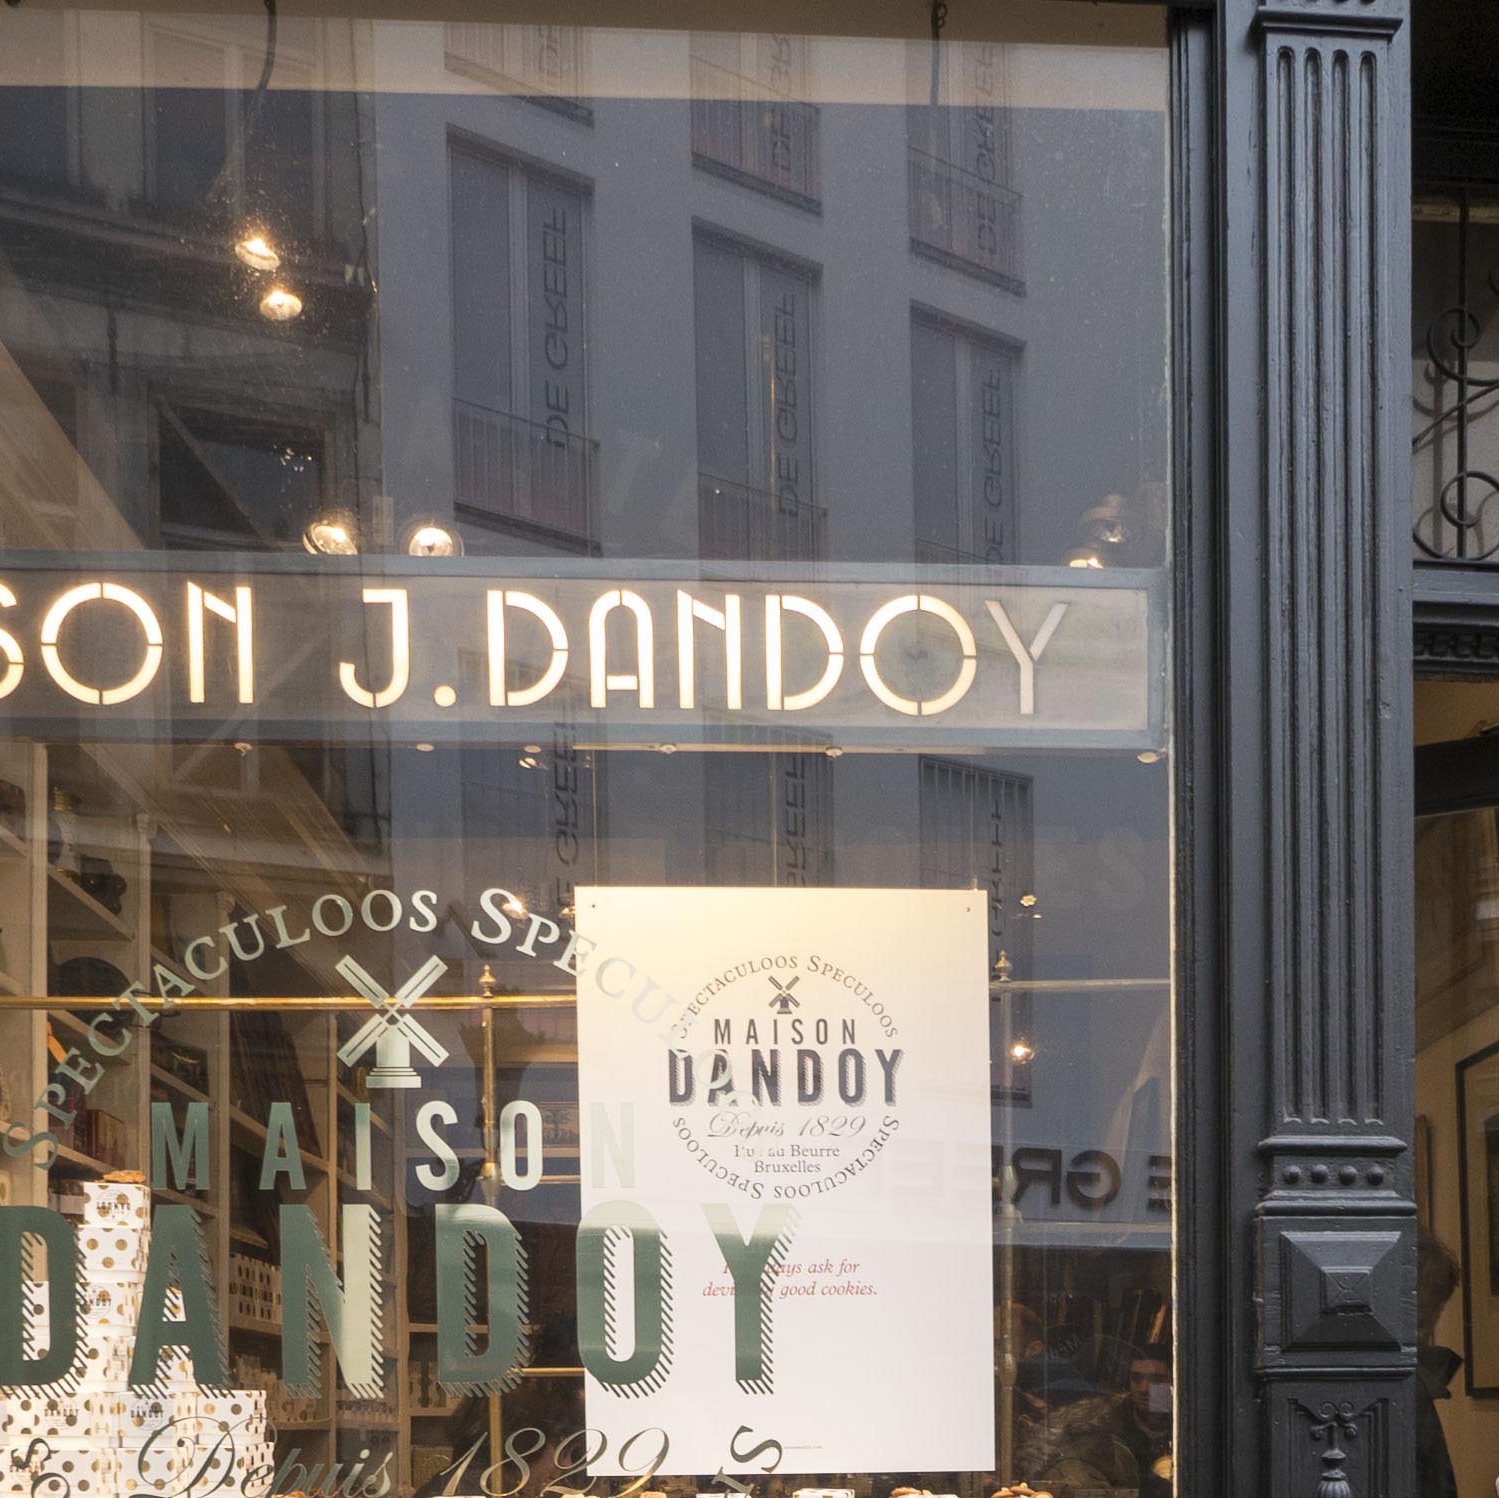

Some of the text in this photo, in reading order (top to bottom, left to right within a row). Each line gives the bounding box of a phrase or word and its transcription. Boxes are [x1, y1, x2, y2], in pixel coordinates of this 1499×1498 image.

[806, 954, 899, 1039] SPECULOOS
[714, 1018, 857, 1045] MAISON
[668, 1047, 905, 1108] DANDOY
[798, 1115, 867, 1138] 1829
[152, 1099, 637, 1191] MAISON
[790, 1143, 840, 1158] Beurre
[754, 1160, 822, 1174] Bruxelles
[807, 1258, 835, 1275] ask
[835, 1257, 861, 1278] for
[779, 1280, 818, 1300] good
[820, 1279, 878, 1297] cookies.
